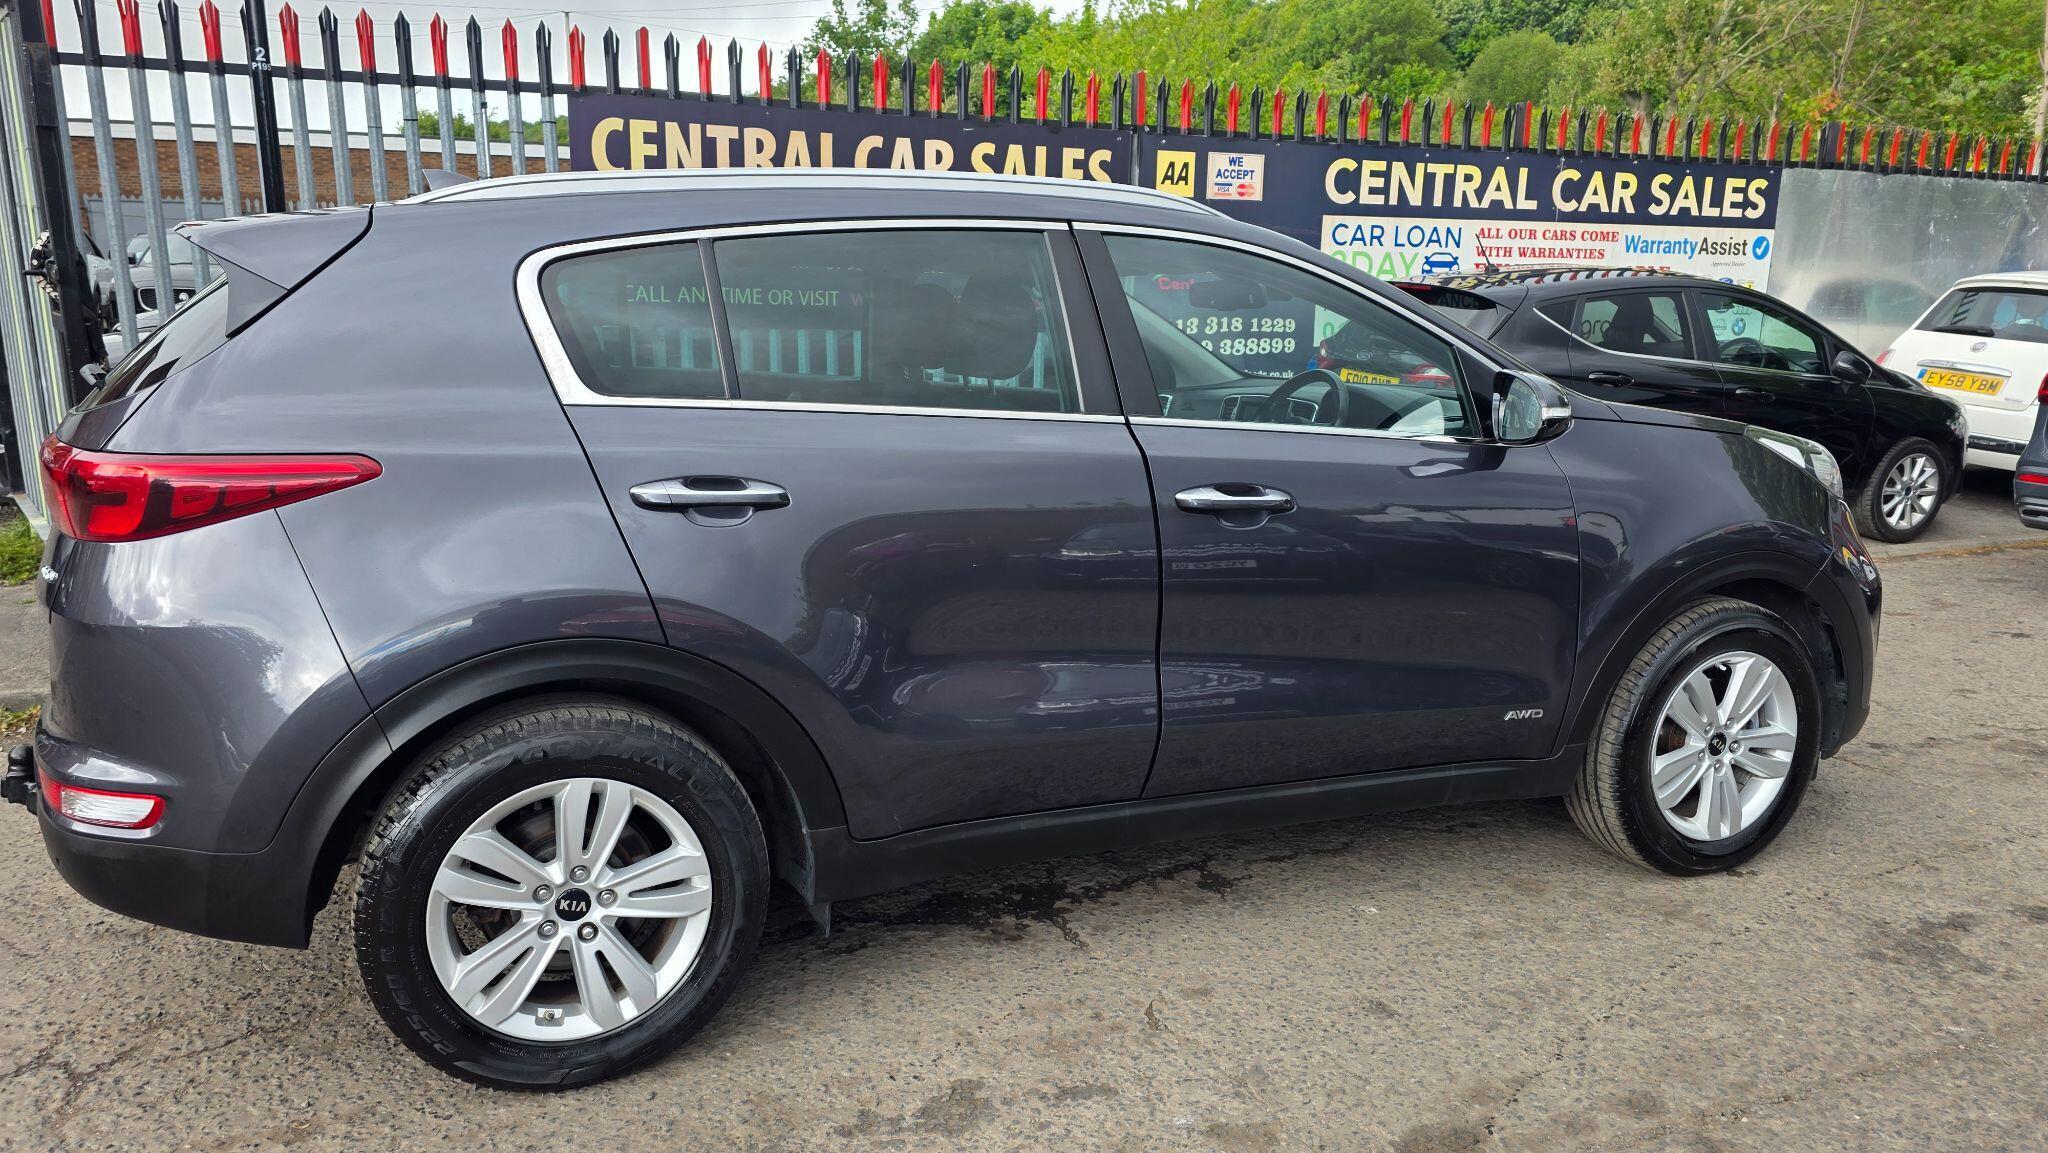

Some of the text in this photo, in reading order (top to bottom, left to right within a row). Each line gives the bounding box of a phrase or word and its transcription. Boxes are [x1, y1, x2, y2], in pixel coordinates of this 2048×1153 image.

[255, 46, 266, 61] 2
[591, 116, 833, 171] CENTRAL
[971, 142, 1112, 183] SALES
[1229, 156, 1243, 167] WE
[1161, 161, 1189, 185] AA
[1216, 168, 1255, 180] ACCEPT
[1325, 158, 1769, 219] CENTRAL CAR SALES
[1331, 223, 1462, 248] CAR LOAN
[1478, 228, 1619, 243] ALL OUR CARS COME
[1475, 246, 1605, 259] WITH WARRANTIES
[768, 289, 793, 305] OR
[798, 290, 840, 306] VISIT
[1204, 317, 1243, 334] 318
[1250, 318, 1296, 333] 1229
[1219, 337, 1296, 356] 388899
[1926, 371, 2000, 393] EY58 YBM
[1503, 709, 1544, 720] AWD
[560, 900, 587, 912] KIA
